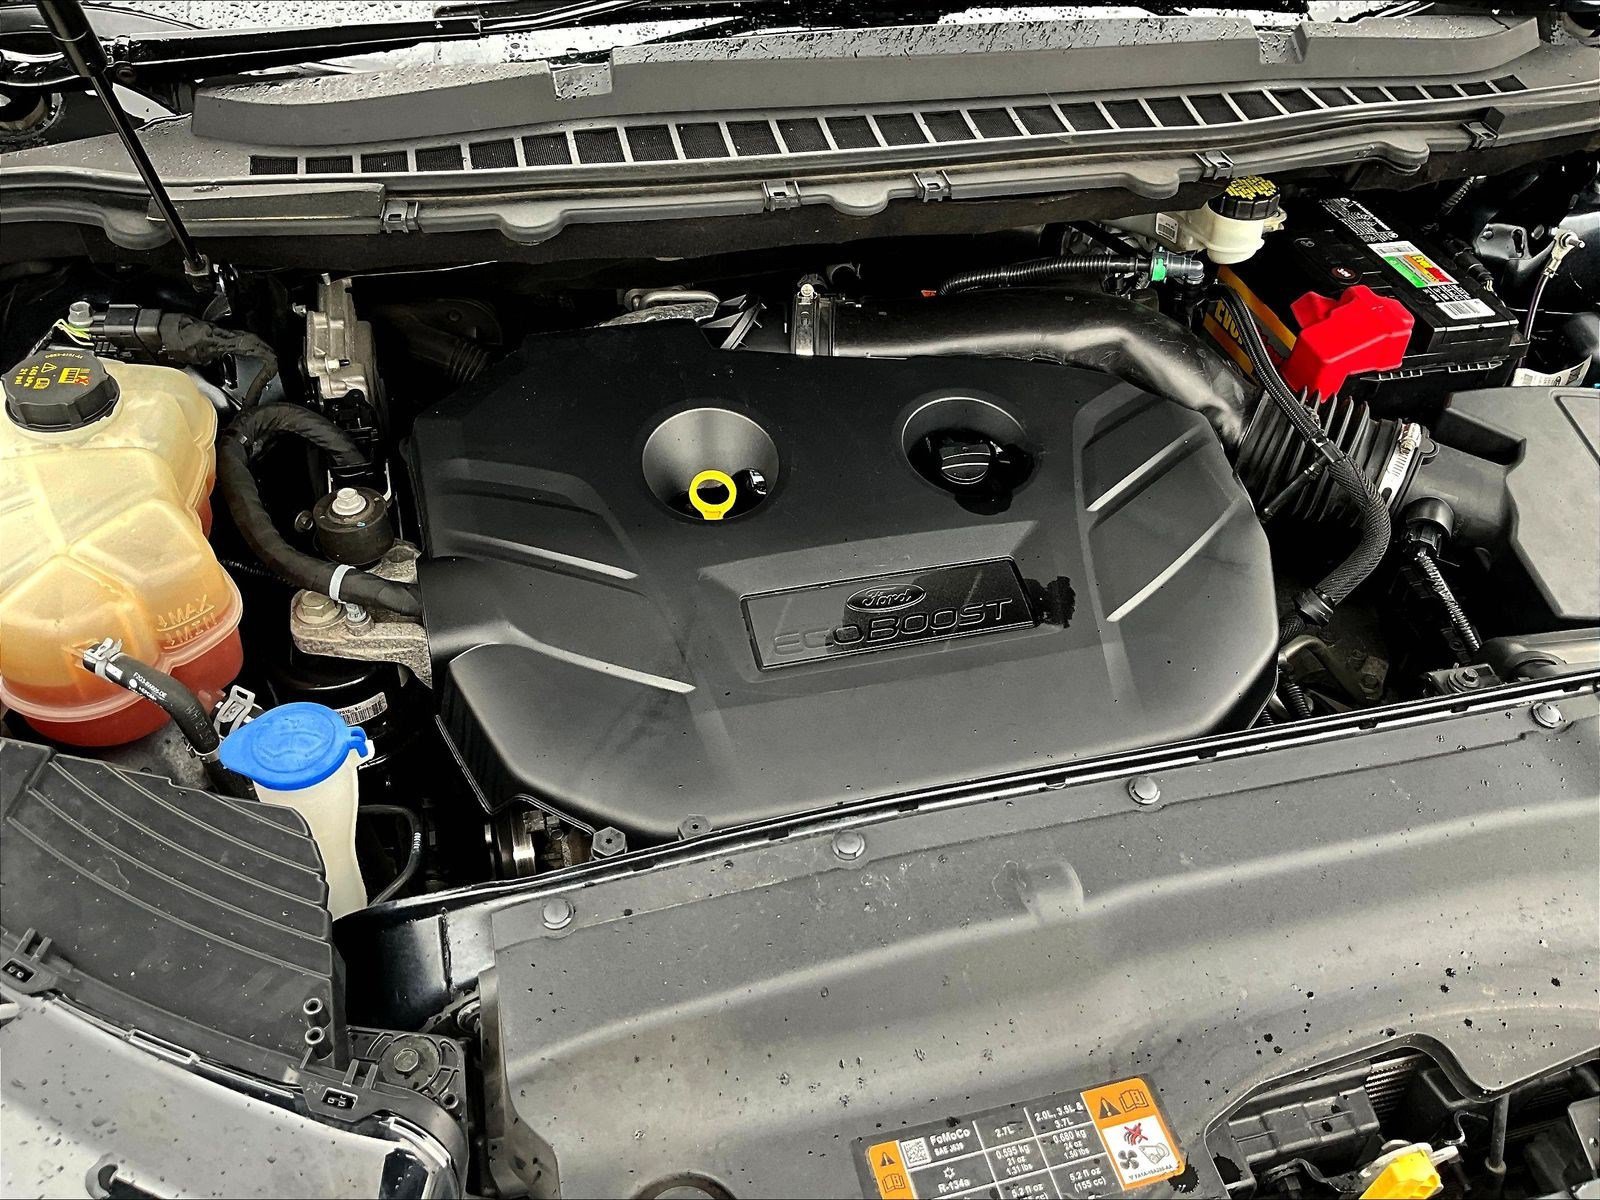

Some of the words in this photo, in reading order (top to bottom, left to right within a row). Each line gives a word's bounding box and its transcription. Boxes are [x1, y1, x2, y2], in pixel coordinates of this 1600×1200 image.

[862, 586, 912, 607] Ford
[168, 594, 208, 626] MAX
[175, 612, 218, 643] MIN
[1034, 1109, 1056, 1122] 2.0L,
[1056, 1105, 1075, 1116] 3.5L
[1075, 1101, 1083, 1111] &
[1054, 1117, 1074, 1129] 3.7L
[929, 1128, 971, 1146] FoMoCo
[994, 1125, 1014, 1138] 2.7L
[1075, 1128, 1087, 1139] kg
[934, 1145, 949, 1157] SAE
[1073, 1140, 1083, 1149] oz
[995, 1146, 1018, 1160] 0.595
[1018, 1143, 1031, 1155] kg
[1078, 1147, 1090, 1156] lbs
[1006, 1157, 1016, 1166] 21
[1016, 1155, 1026, 1163] oz
[1006, 1165, 1021, 1176] 1.31
[1021, 1163, 1033, 1172] lbs
[1091, 1167, 1102, 1176] oz
[937, 1178, 971, 1194] R-134a
[1033, 1183, 1043, 1192] oz
[1074, 1179, 1092, 1193] (155
[1093, 1175, 1107, 1186] cc)
